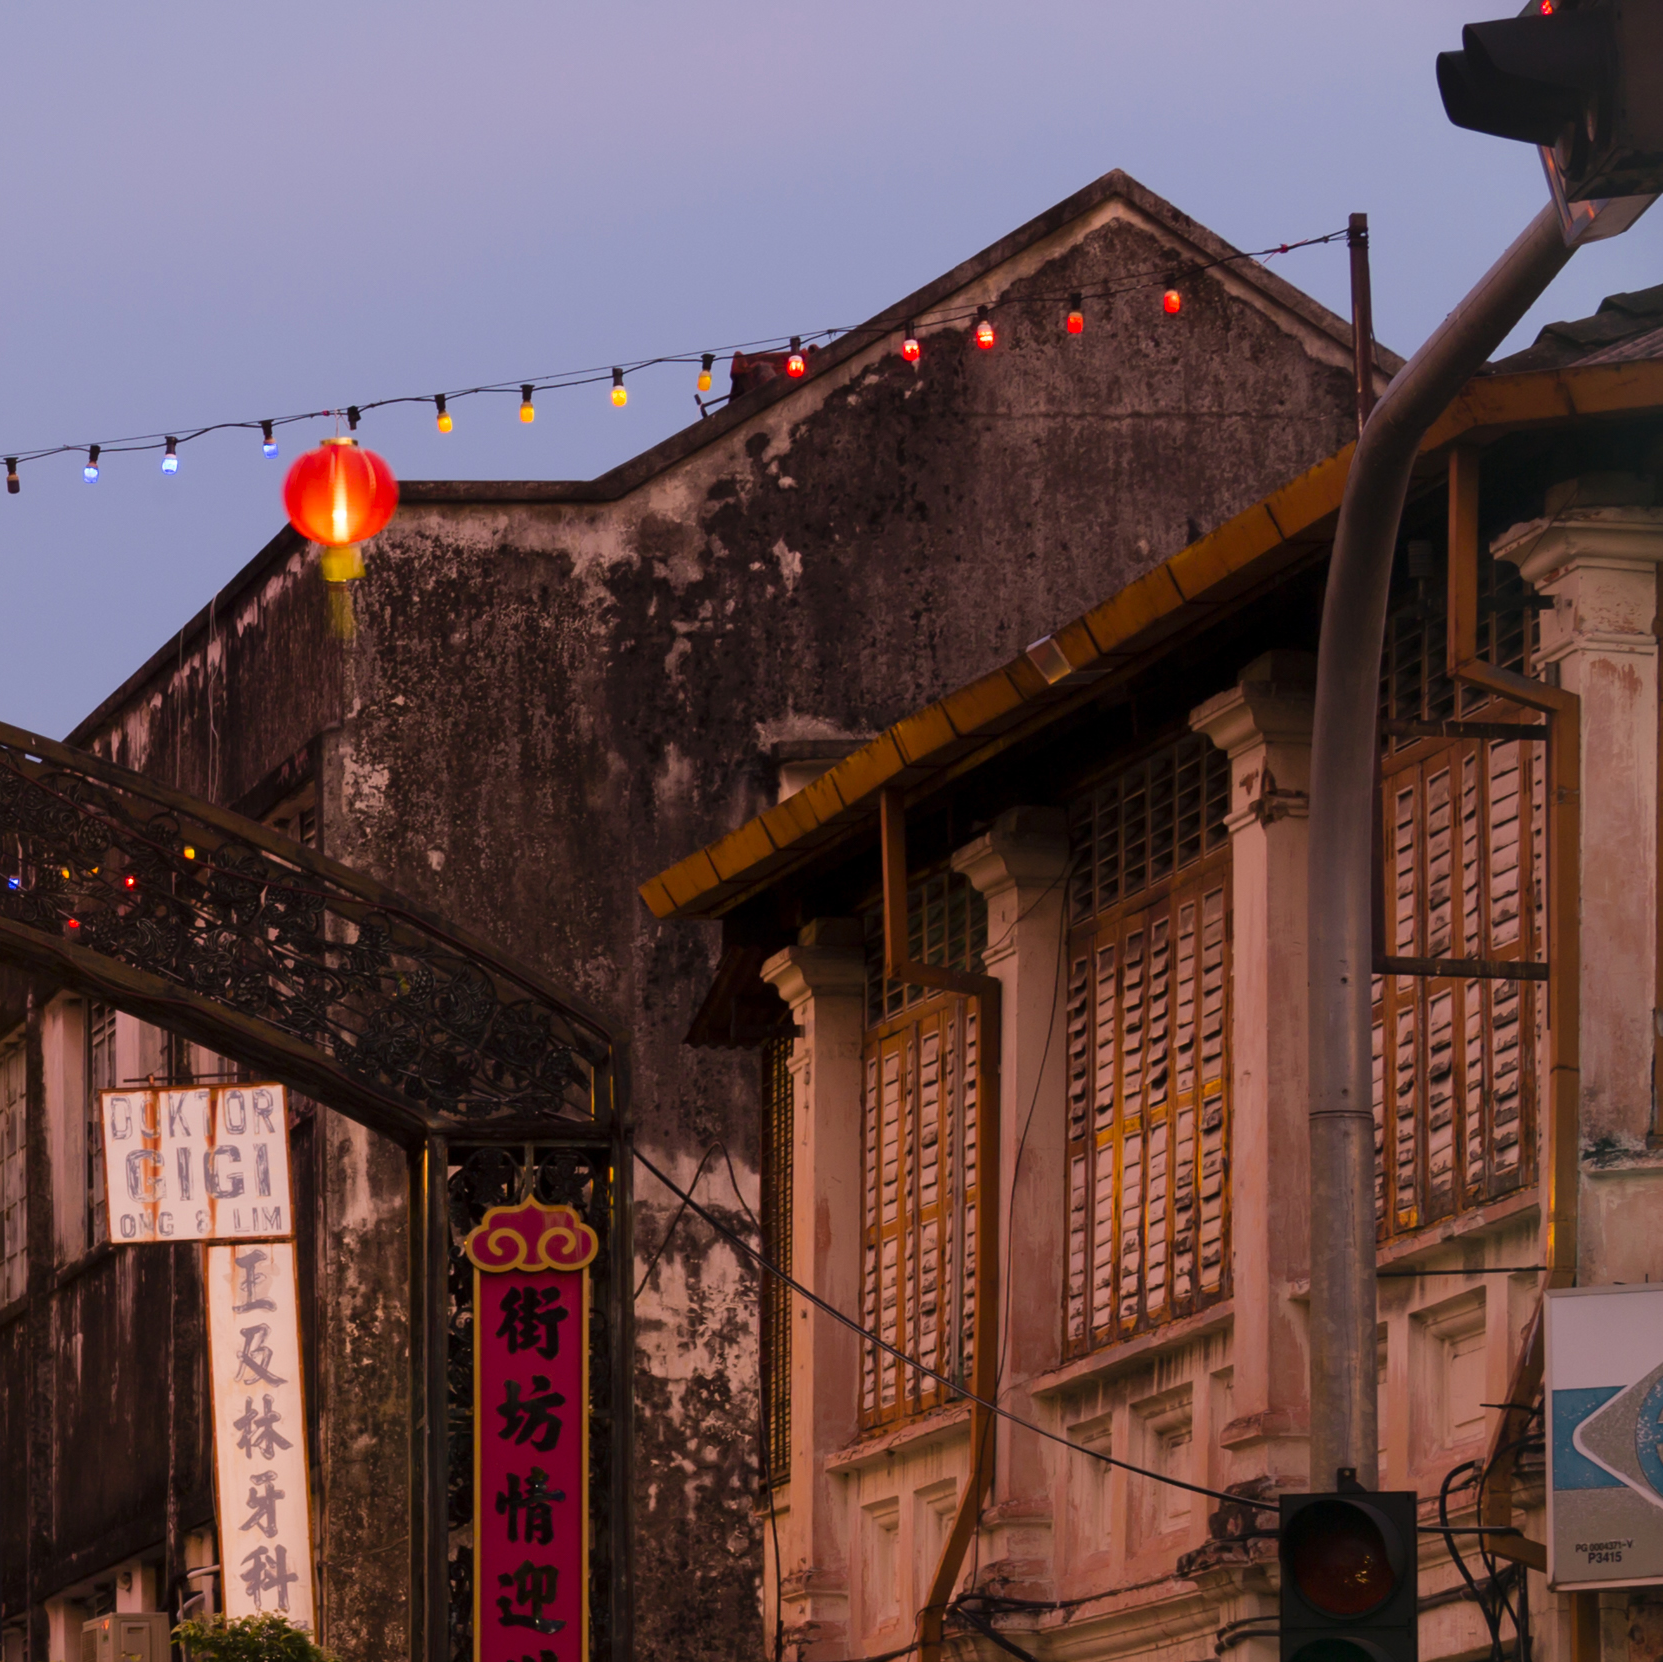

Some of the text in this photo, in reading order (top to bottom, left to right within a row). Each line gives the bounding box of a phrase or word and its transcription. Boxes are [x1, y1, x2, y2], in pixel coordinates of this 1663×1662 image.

[110, 1088, 277, 1141] DOKTOR
[124, 1143, 272, 1204] GIGI
[233, 1205, 283, 1234] LIM
[1587, 1551, 1623, 1565] P3415
